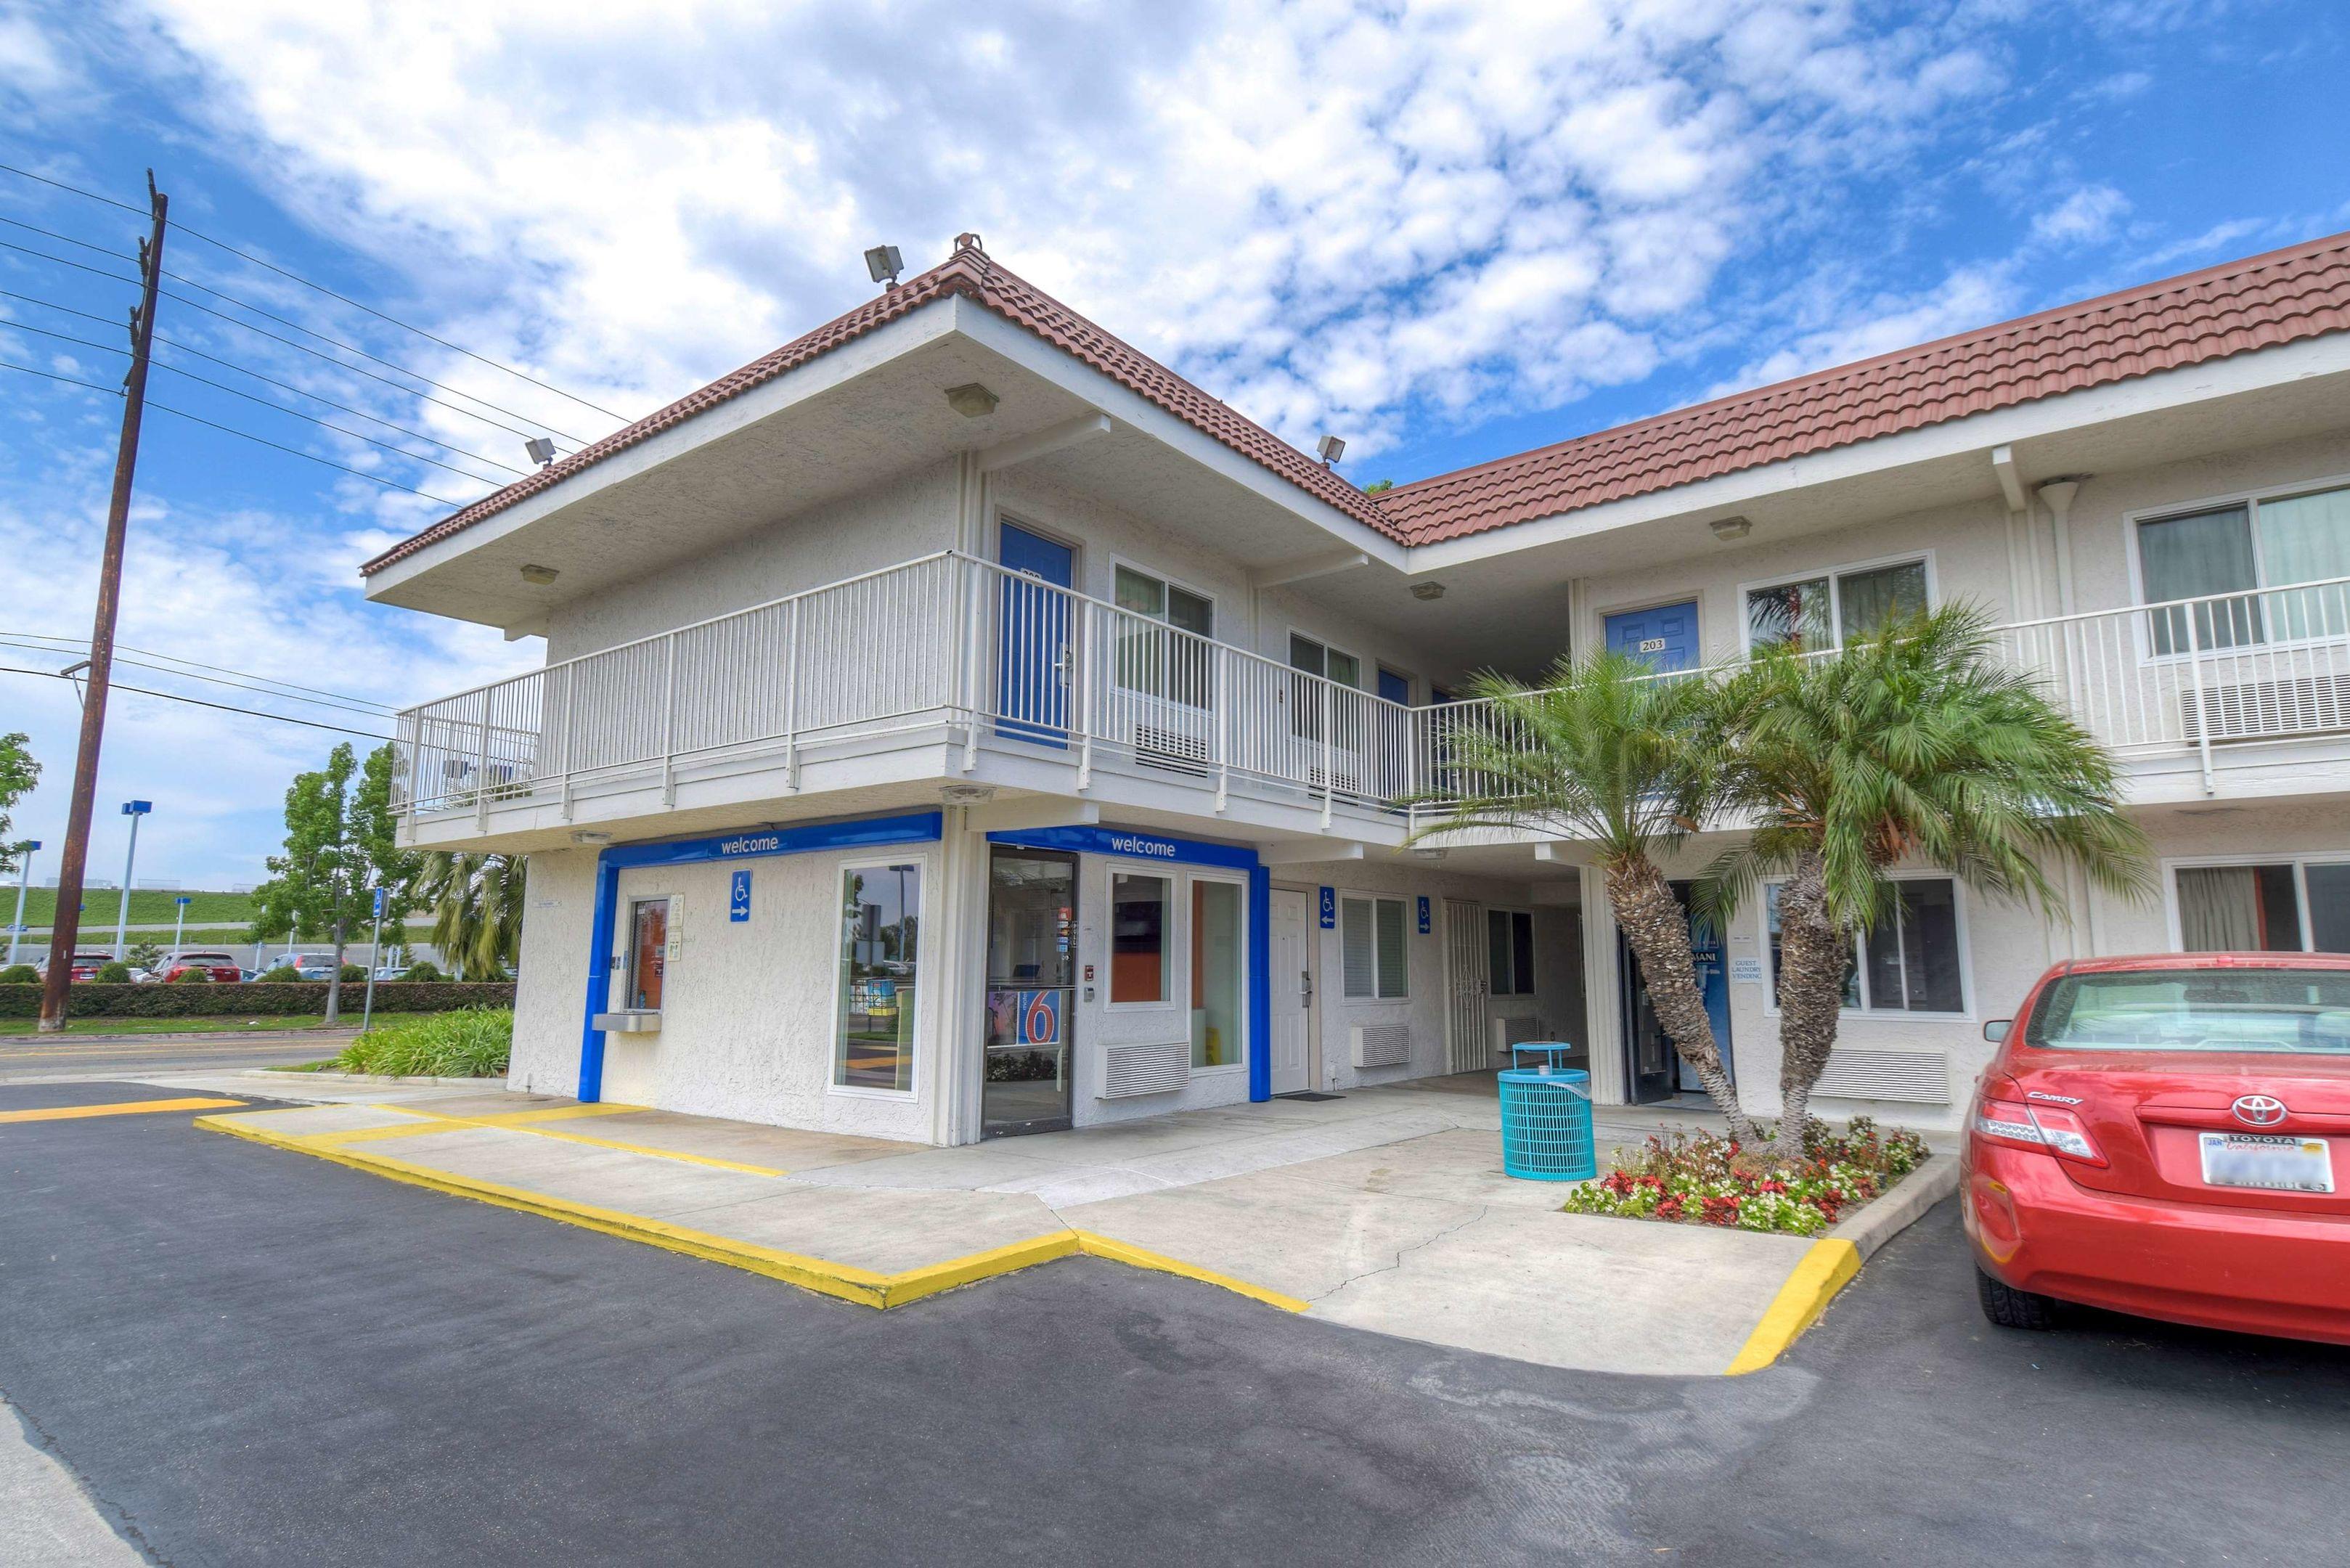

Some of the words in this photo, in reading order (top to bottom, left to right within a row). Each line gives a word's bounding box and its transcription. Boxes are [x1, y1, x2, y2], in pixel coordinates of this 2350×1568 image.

[1643, 640, 1662, 650] 203
[722, 837, 778, 854] welcome
[1111, 836, 1175, 857] welcome
[1025, 990, 1055, 1044] 6
[2227, 1141, 2294, 1151] California
[2231, 1135, 2294, 1145] TOYOTA
